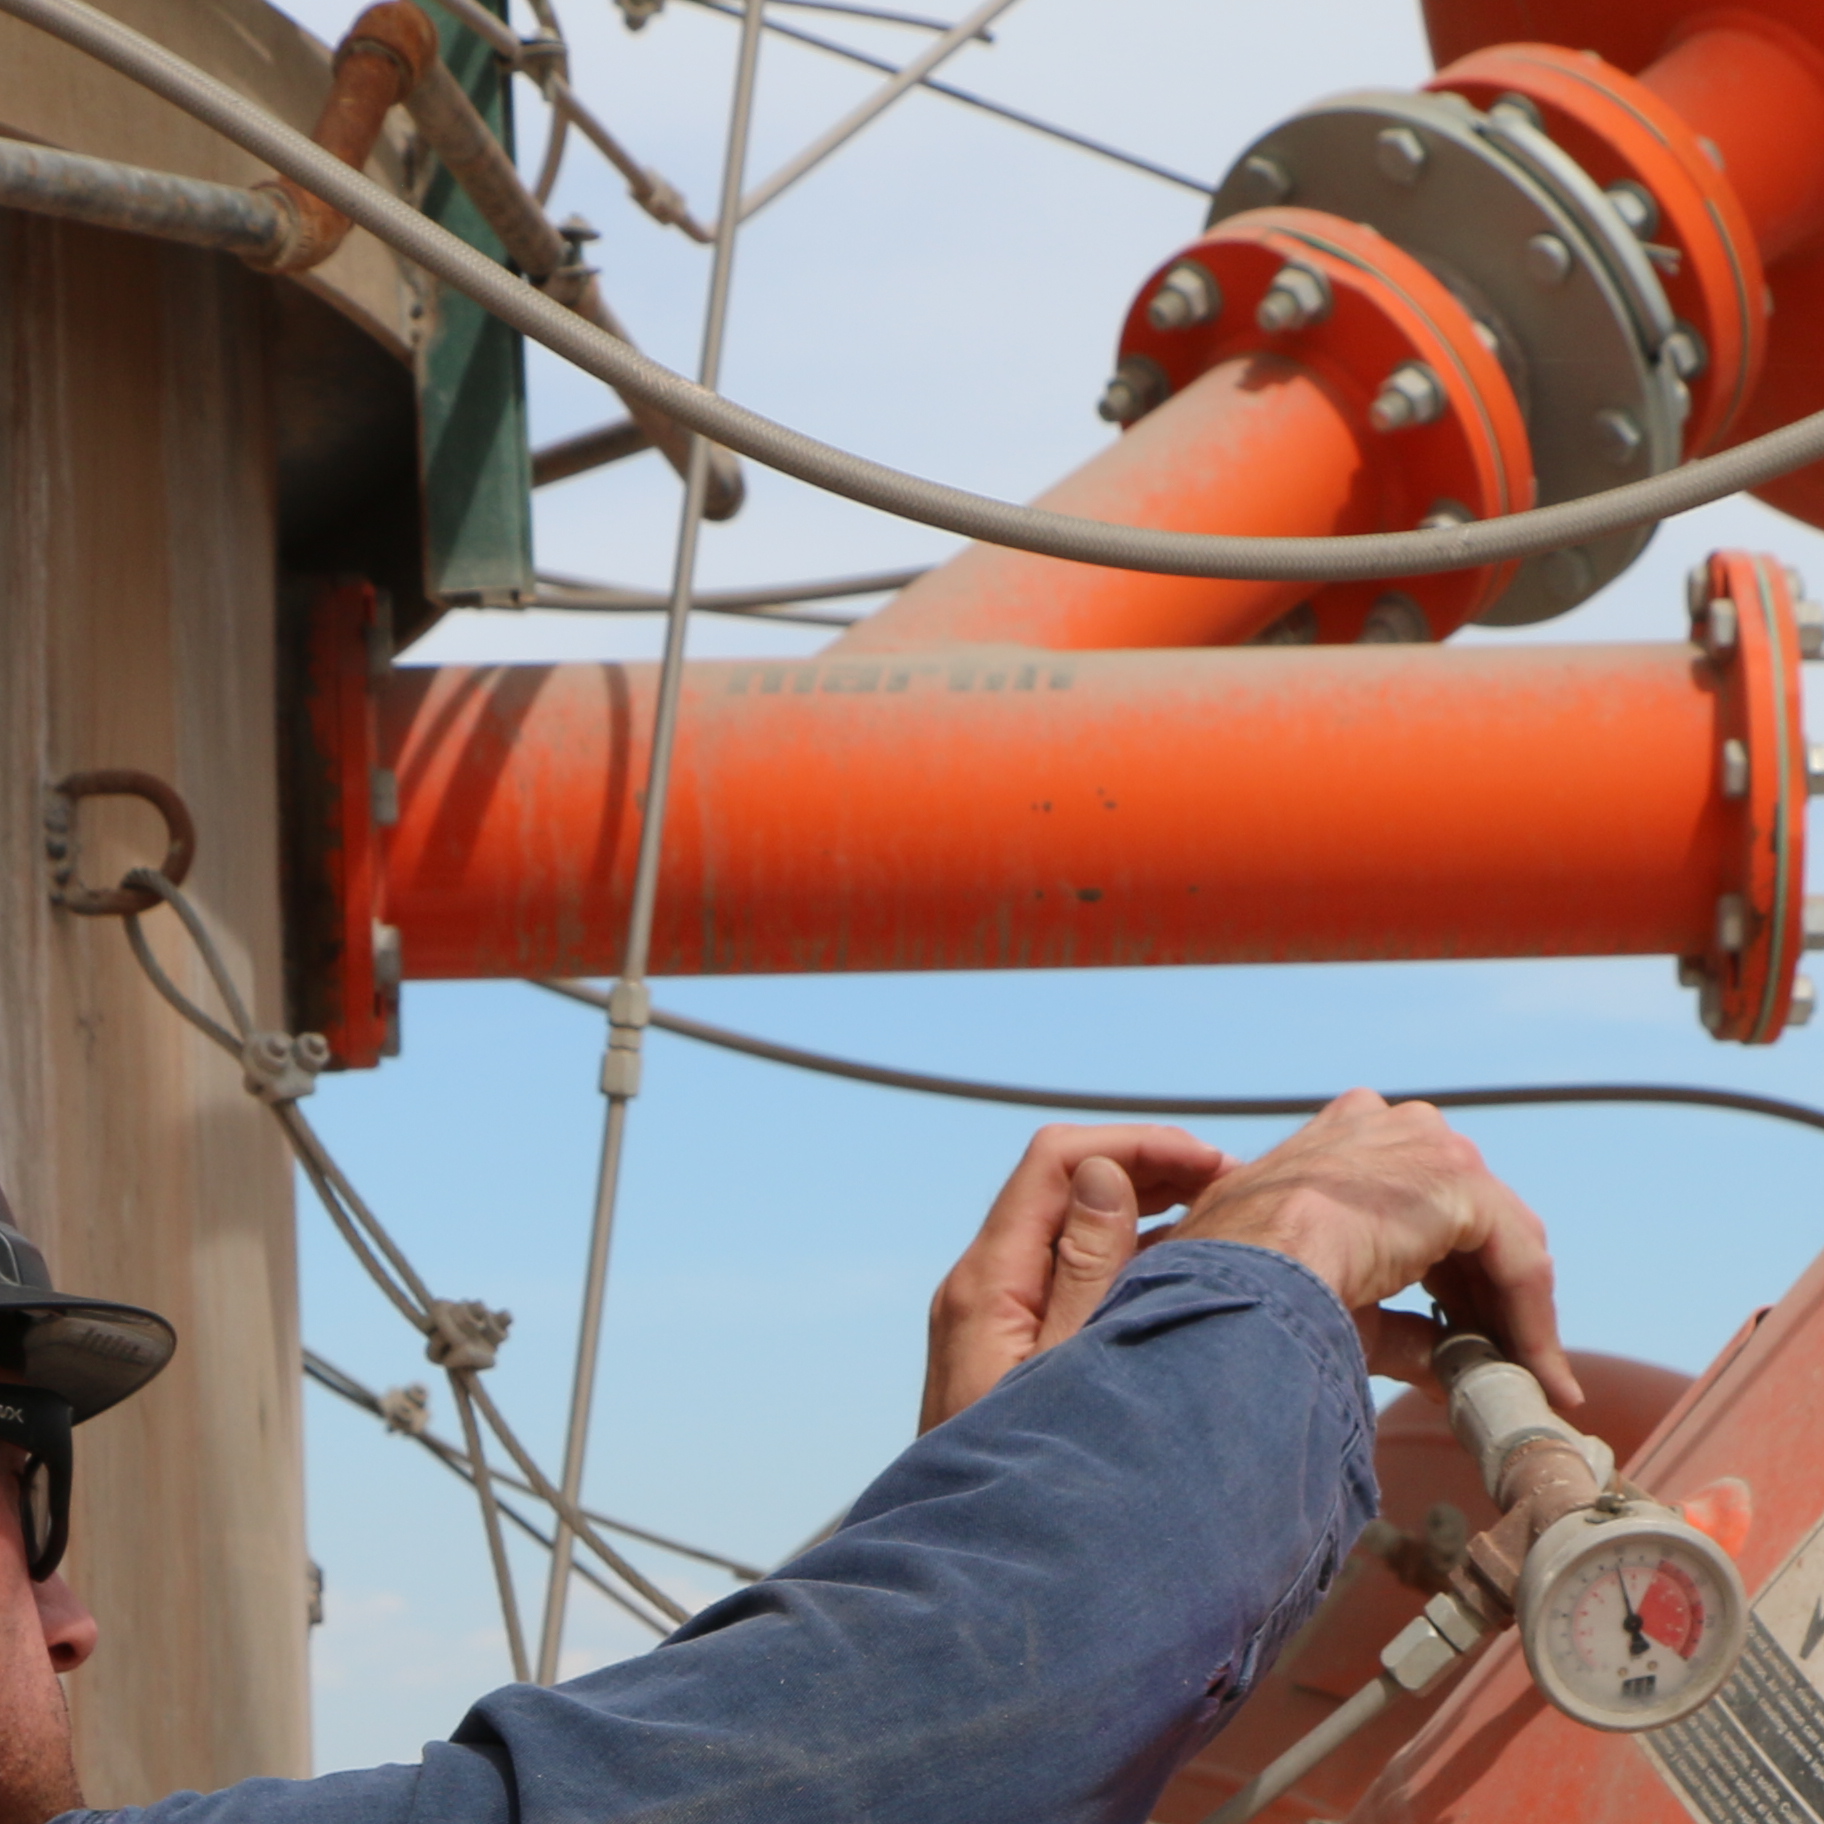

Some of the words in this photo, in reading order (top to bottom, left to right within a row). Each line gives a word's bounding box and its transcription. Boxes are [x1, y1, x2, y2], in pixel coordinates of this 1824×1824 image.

[1775, 1691, 1807, 1727] cannon
[1801, 1723, 1821, 1745] can
[1782, 1729, 1814, 1764] severe
[1733, 1775, 1761, 1806] sobre
[1755, 1800, 1771, 1817] el
[1755, 1772, 1786, 1806] solde.
